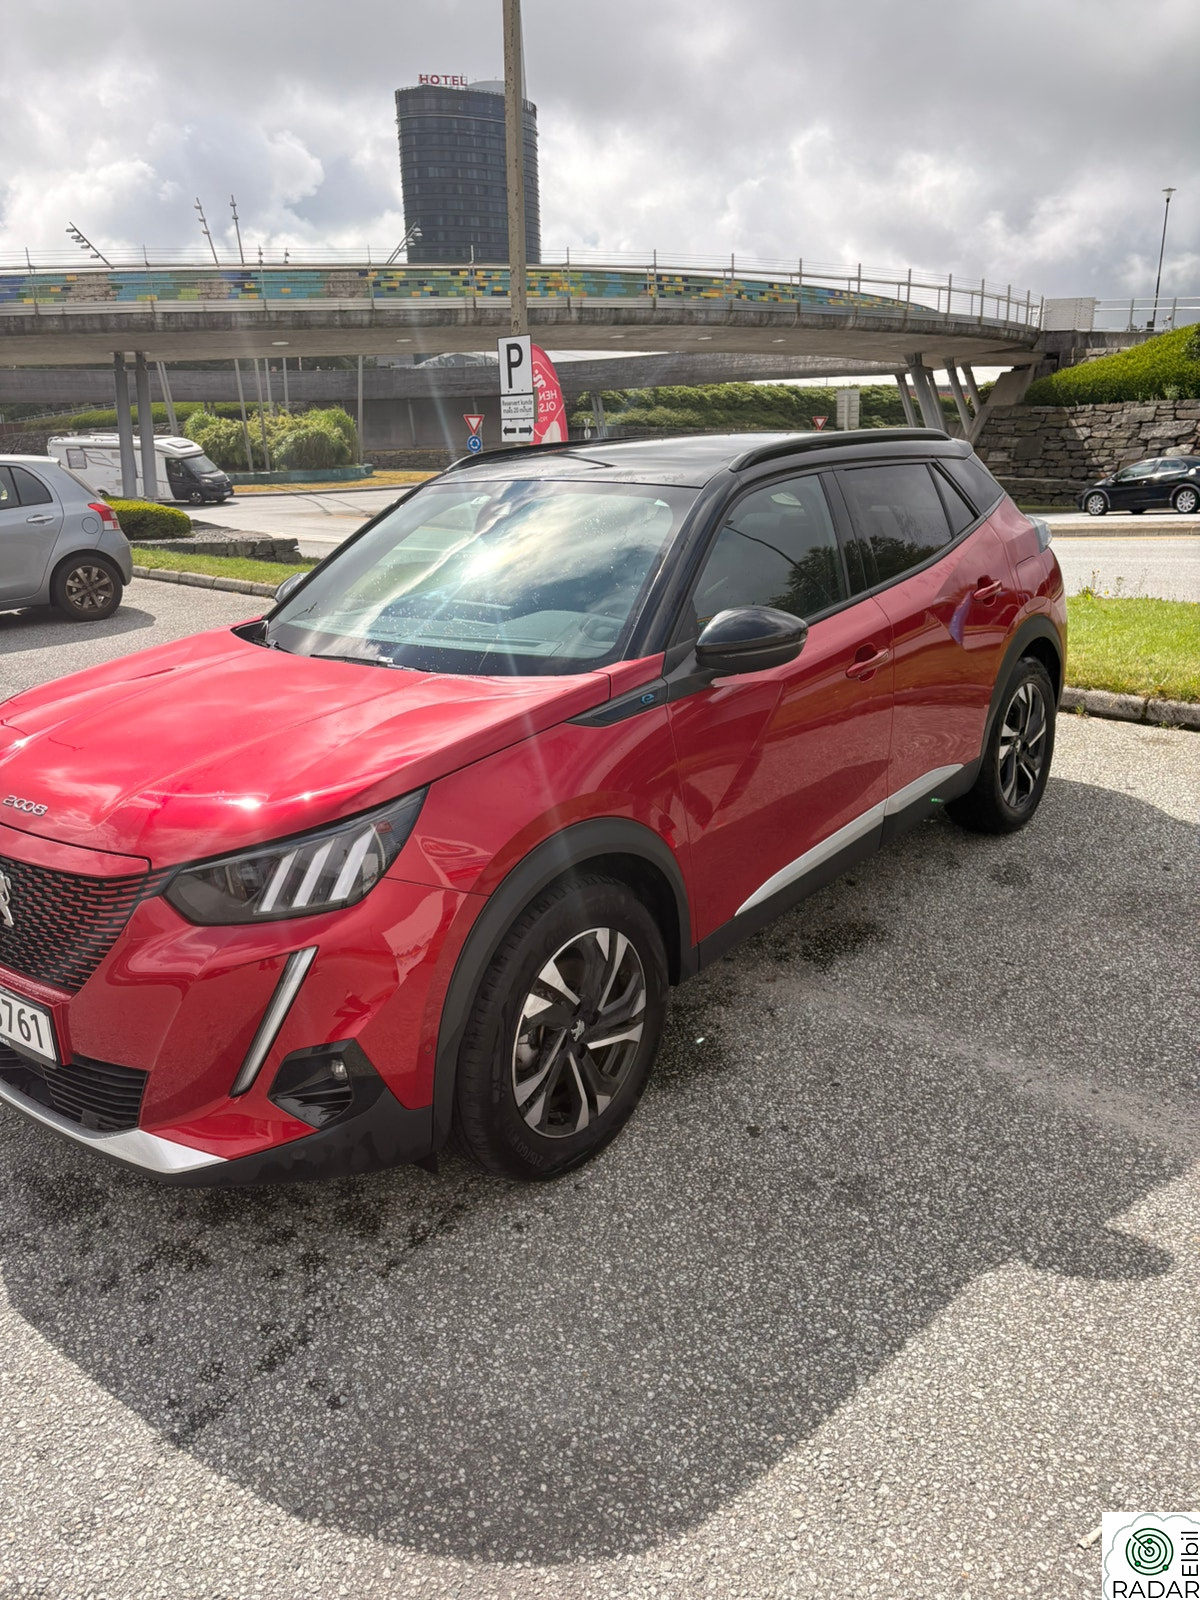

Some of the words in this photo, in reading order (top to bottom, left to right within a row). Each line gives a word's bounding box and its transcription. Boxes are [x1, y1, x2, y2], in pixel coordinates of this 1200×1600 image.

[418, 74, 468, 87] HOTEL
[506, 342, 524, 389] P
[2, 794, 48, 817] 2008
[0, 998, 44, 1049] 761
